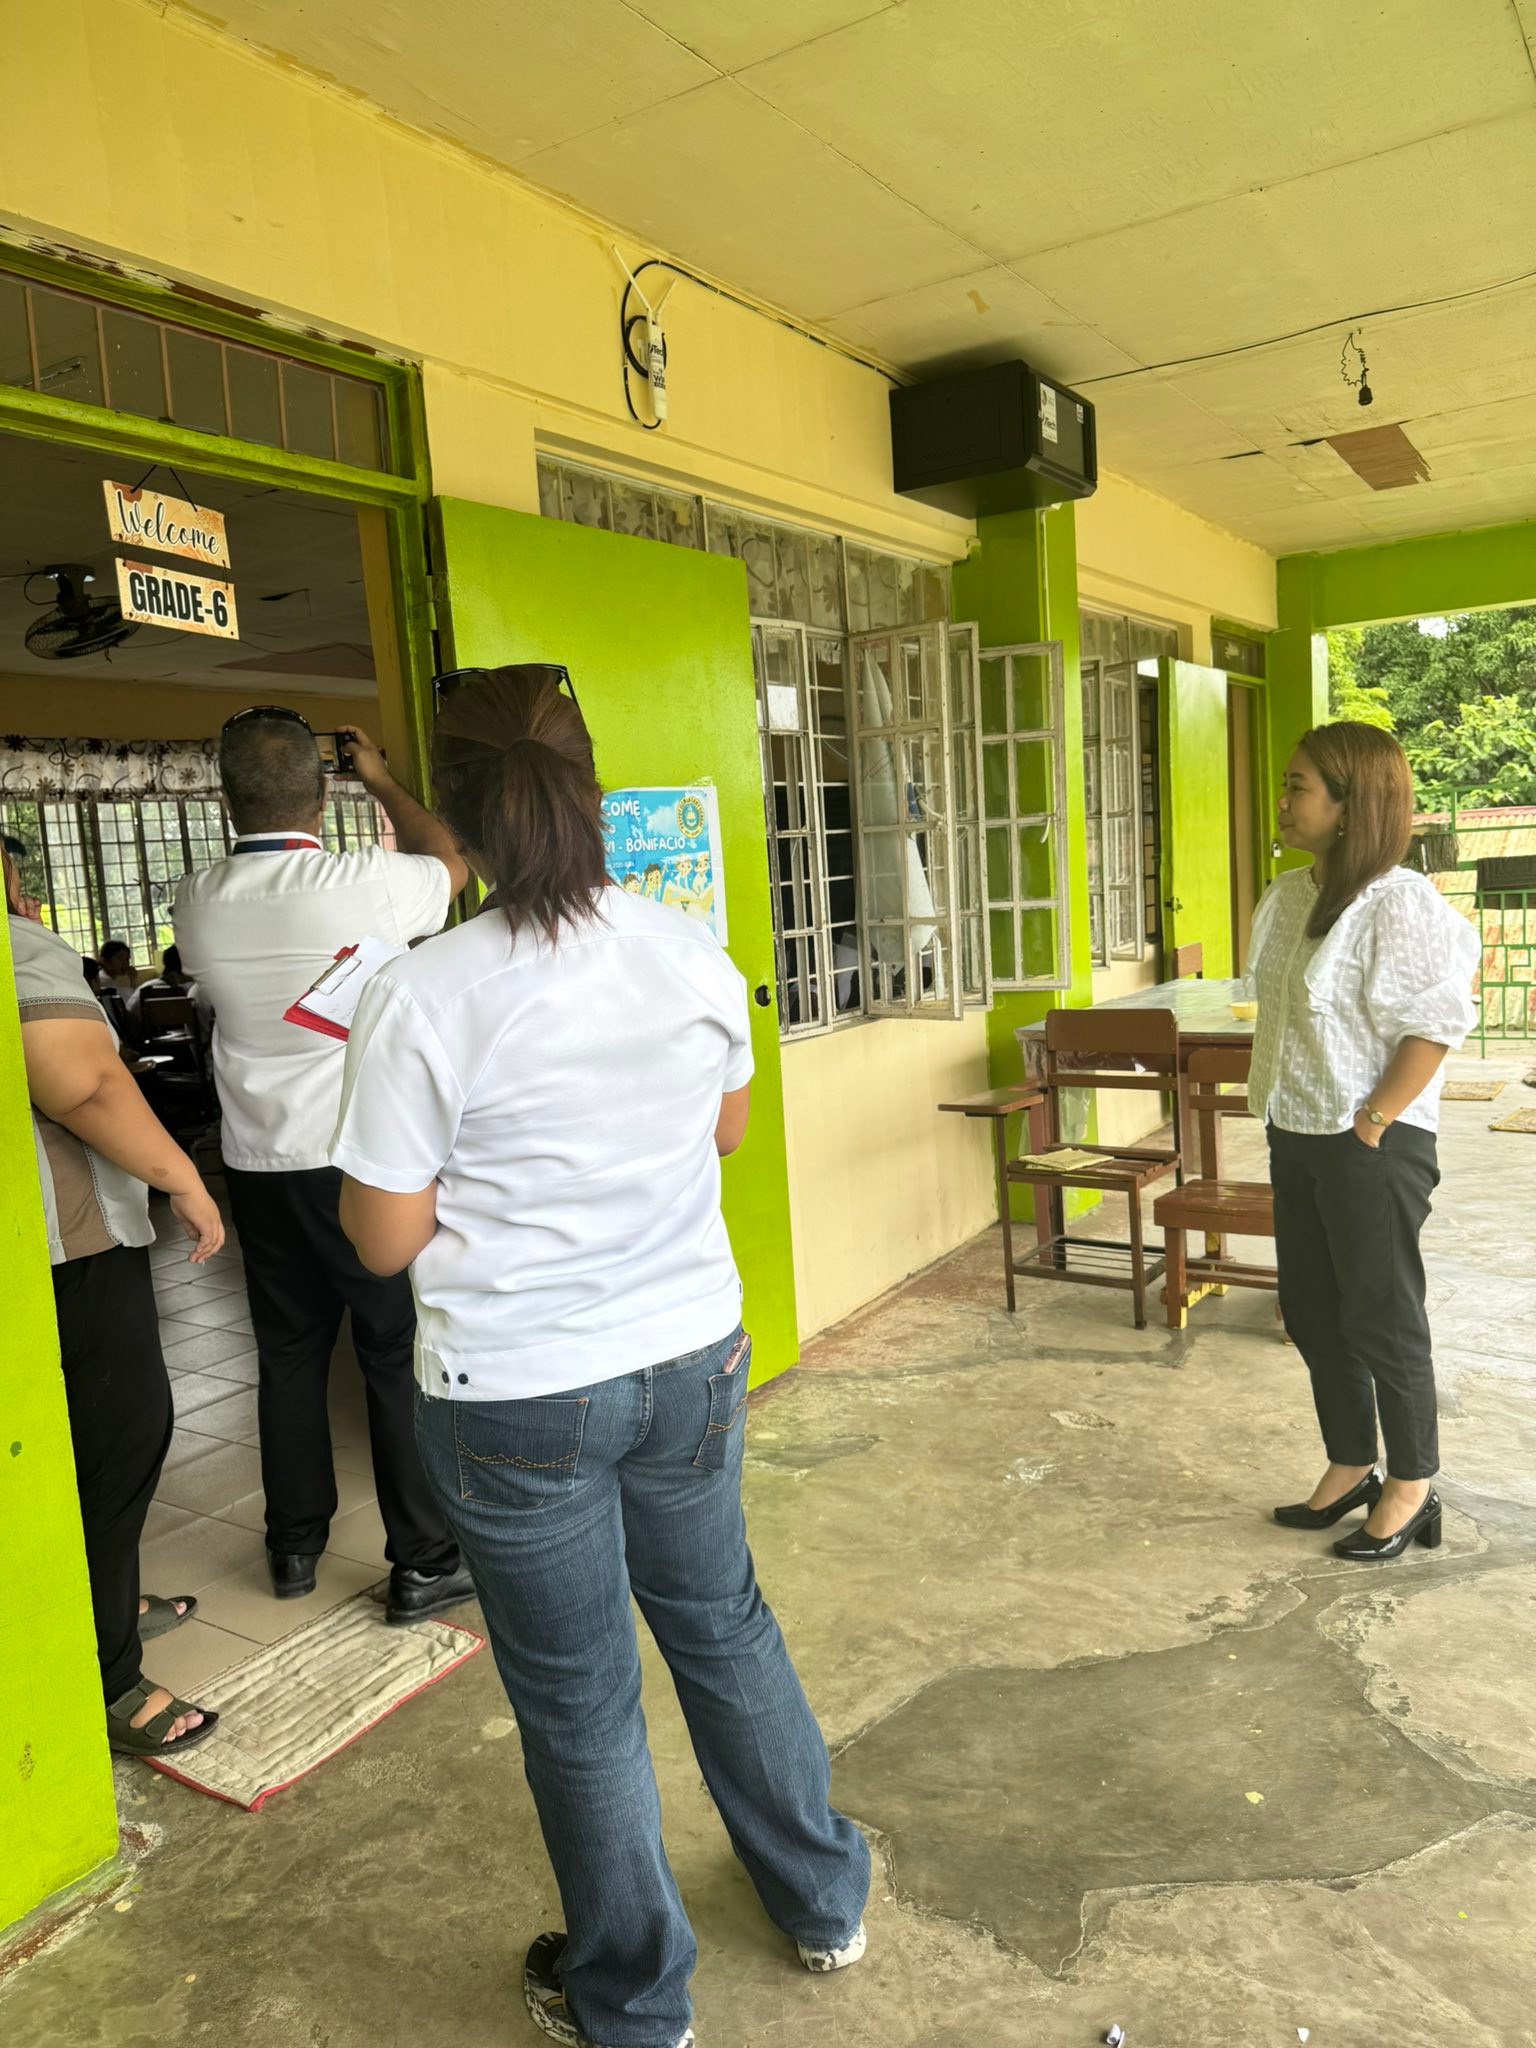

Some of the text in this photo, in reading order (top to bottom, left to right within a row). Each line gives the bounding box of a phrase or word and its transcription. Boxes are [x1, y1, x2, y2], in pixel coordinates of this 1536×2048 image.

[117, 490, 219, 554] Welcome
[129, 571, 228, 627] GRADE-6
[601, 800, 640, 816] COME
[626, 837, 686, 853] BONIFACIO
